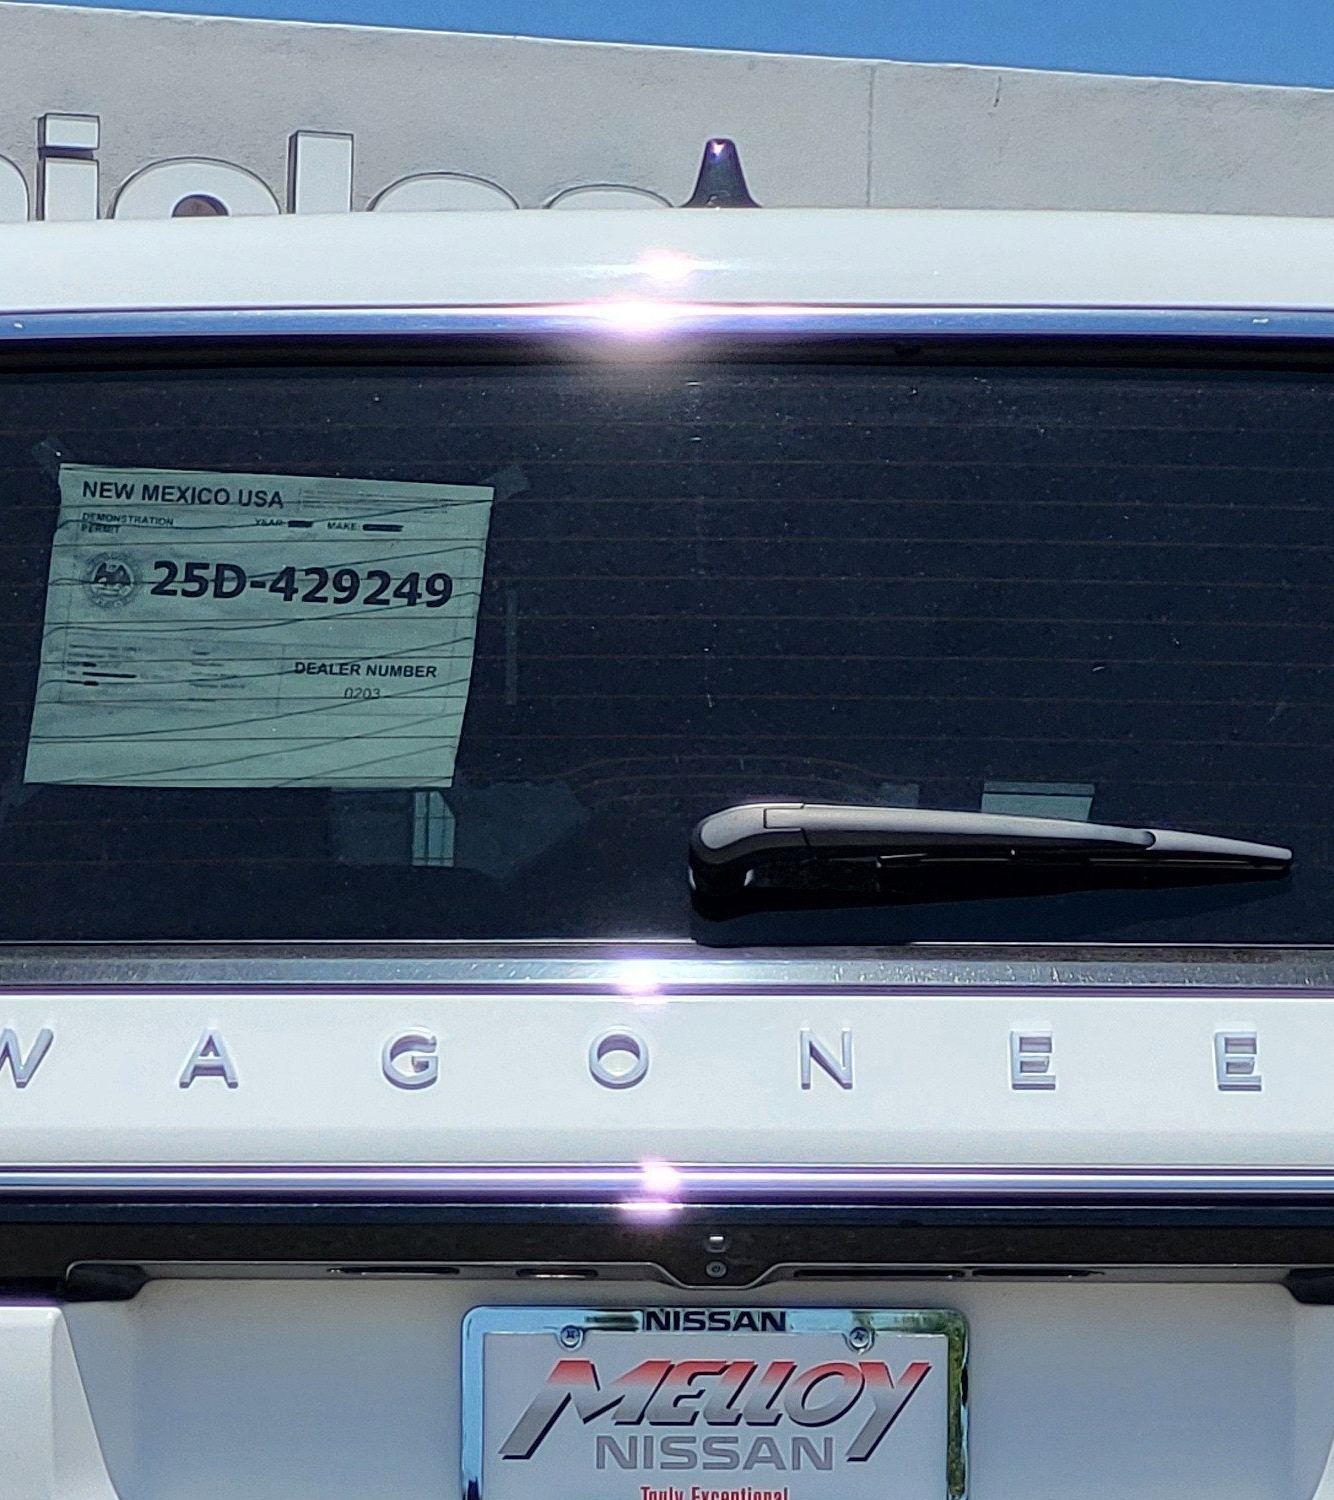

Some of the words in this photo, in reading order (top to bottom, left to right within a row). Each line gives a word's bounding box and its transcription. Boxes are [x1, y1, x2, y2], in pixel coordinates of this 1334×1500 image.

[82, 481, 135, 500] NEW
[141, 484, 230, 506] MEXICO
[238, 488, 284, 509] USA
[81, 512, 174, 526] DEMONSTRATION
[150, 560, 454, 608] 25D-429249
[294, 661, 361, 676] DEALER
[366, 664, 437, 678] NUMBER
[644, 1309, 787, 1332] NISSAN
[498, 1360, 932, 1462] MELLOY
[596, 1435, 834, 1470] NISSAN
